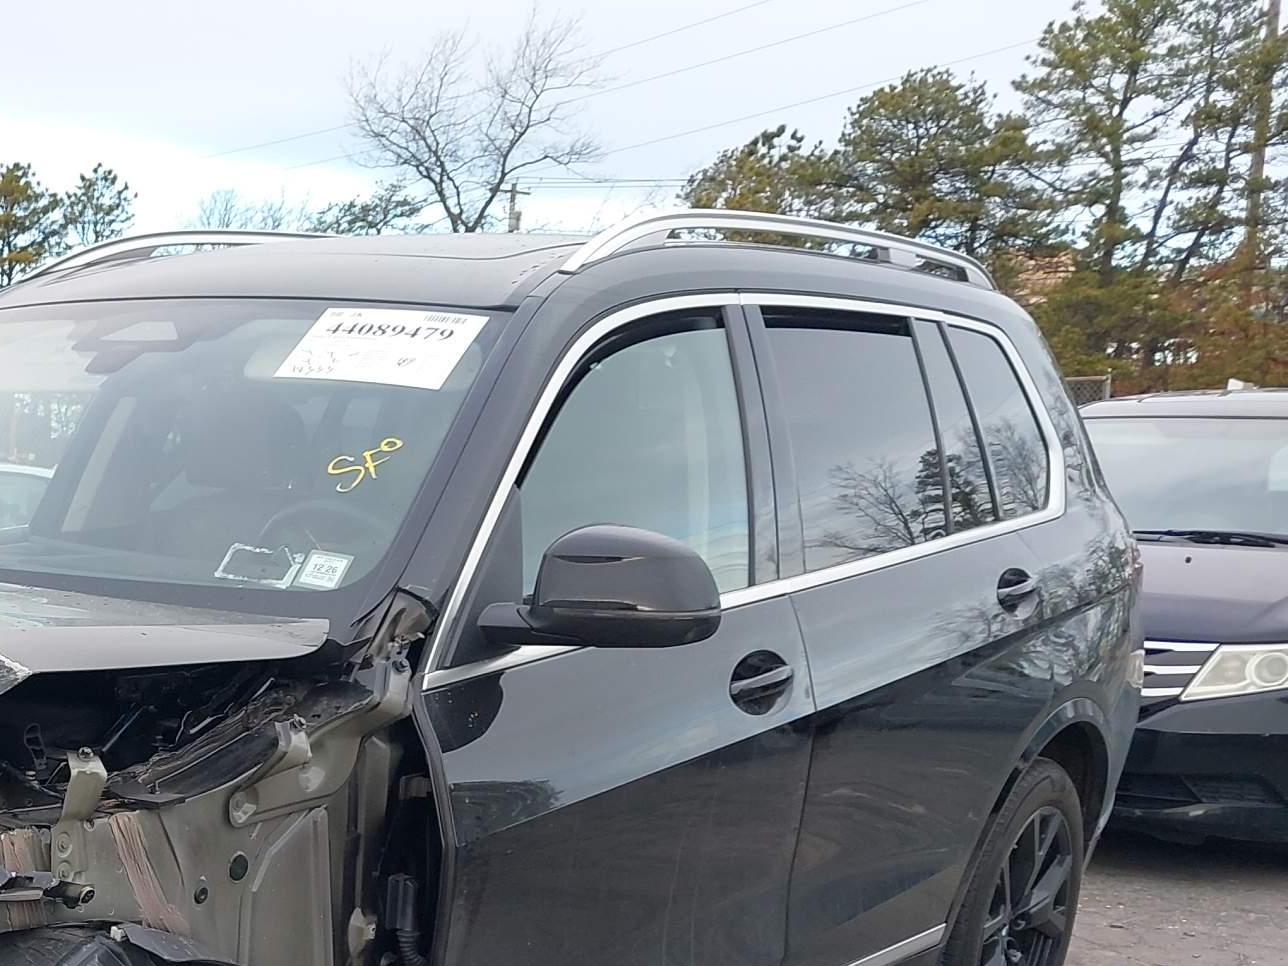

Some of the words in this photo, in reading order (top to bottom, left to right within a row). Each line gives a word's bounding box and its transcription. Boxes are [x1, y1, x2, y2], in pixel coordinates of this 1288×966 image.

[326, 321, 455, 340] 44089479
[313, 562, 325, 571] 12
[327, 564, 339, 574] 26
